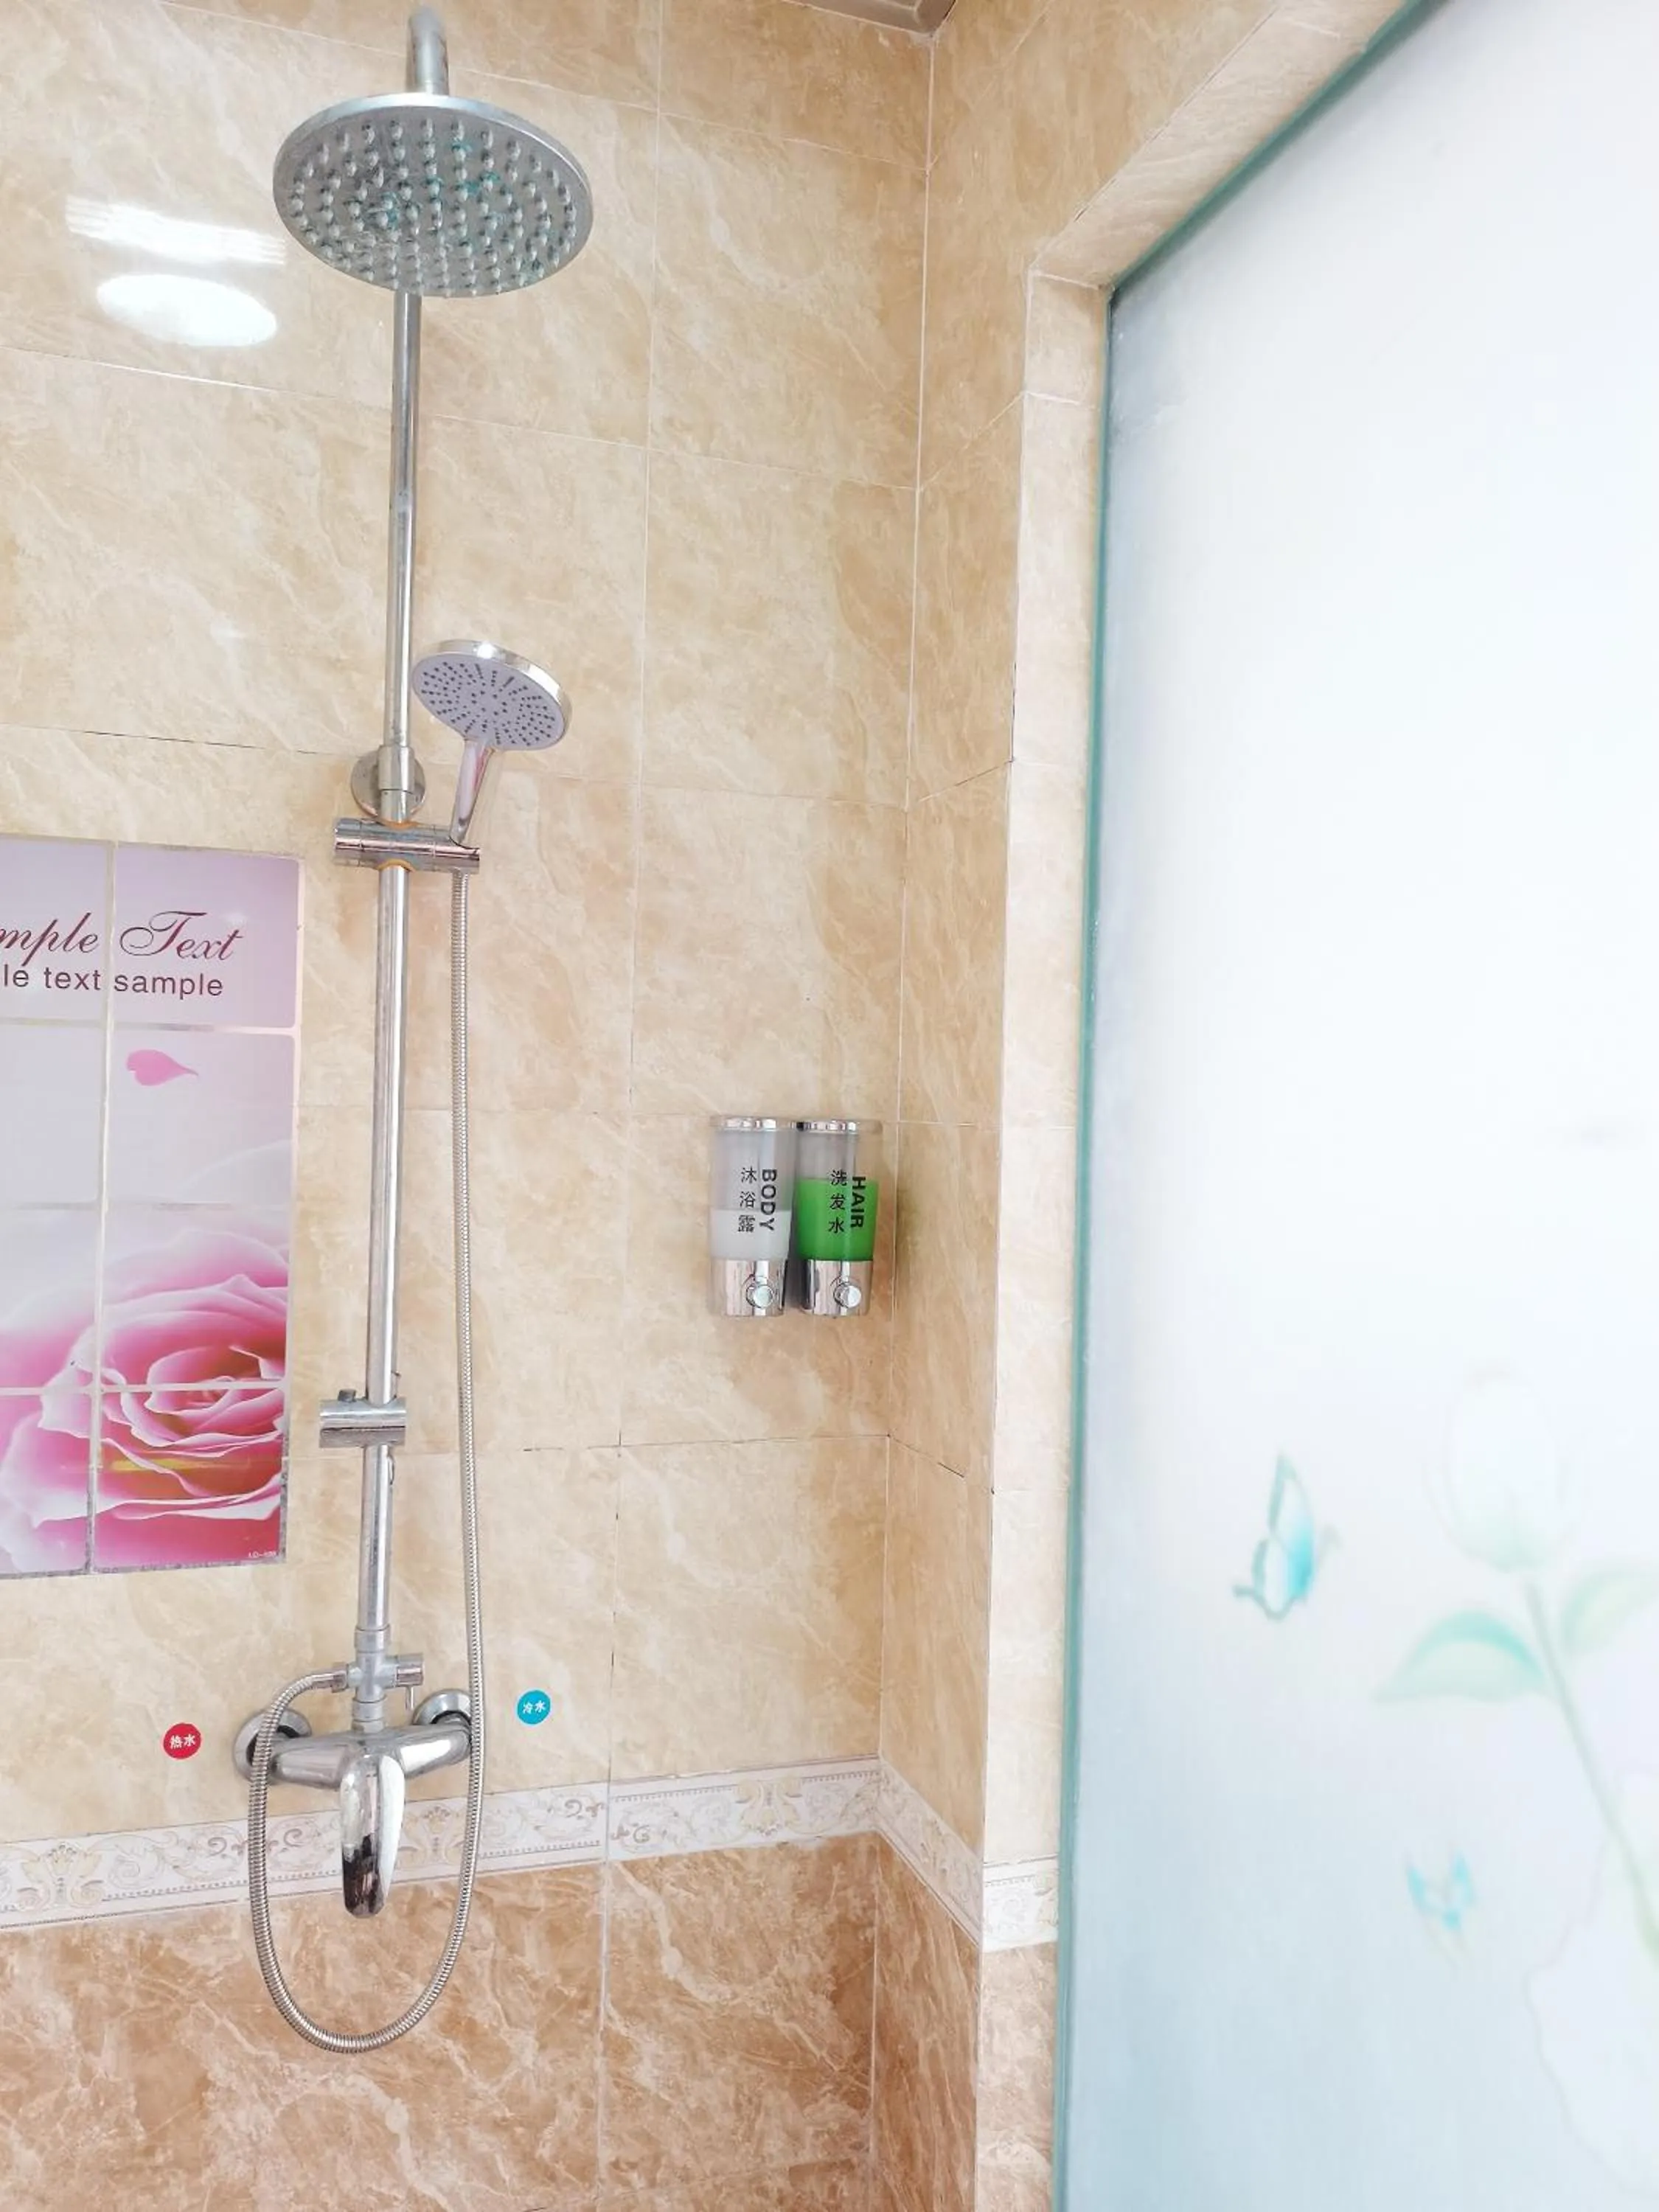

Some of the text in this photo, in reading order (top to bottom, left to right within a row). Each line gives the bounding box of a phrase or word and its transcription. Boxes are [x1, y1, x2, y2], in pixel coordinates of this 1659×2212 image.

[119, 911, 243, 960] Text
[4, 964, 223, 1000] le text sample
[737, 1166, 757, 1232] 沐浴露
[759, 1169, 777, 1231] BODY
[828, 1169, 848, 1234] 洗发水
[849, 1176, 866, 1228] HAIR
